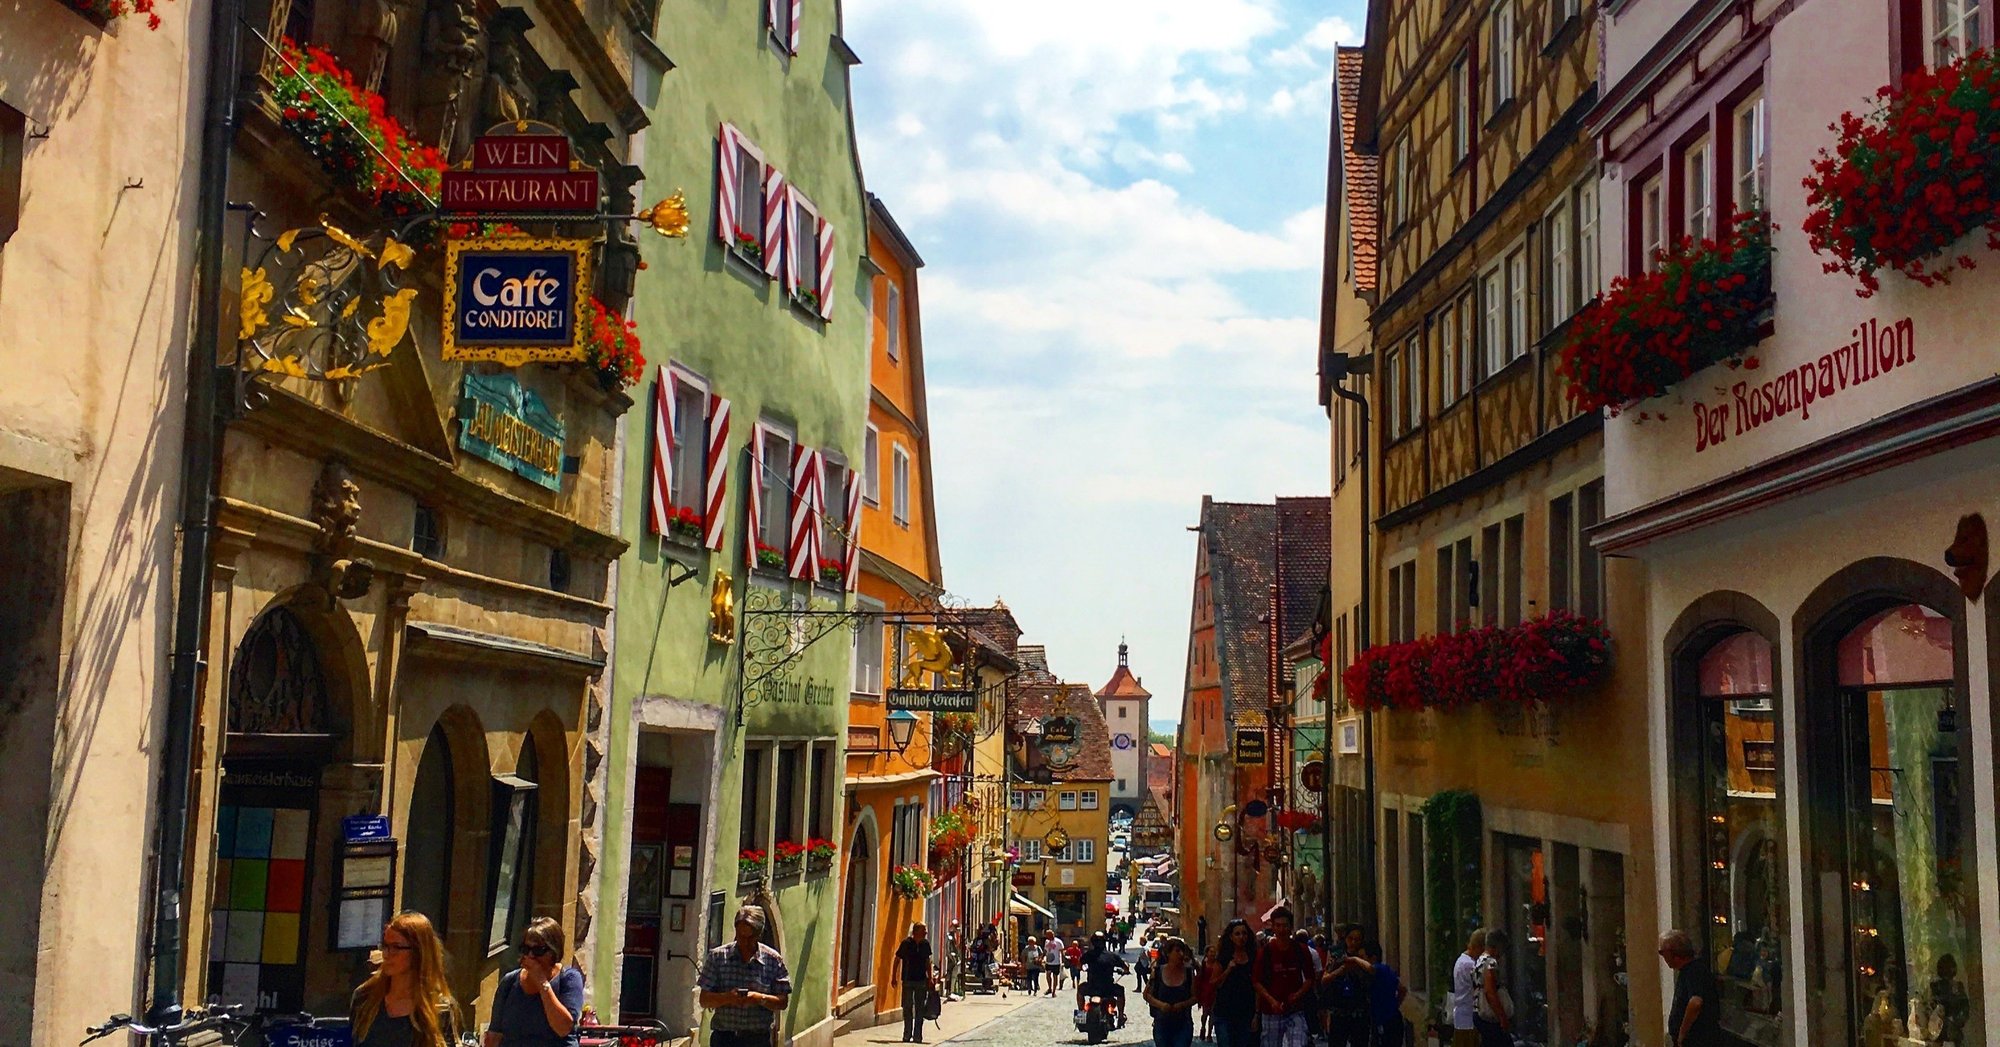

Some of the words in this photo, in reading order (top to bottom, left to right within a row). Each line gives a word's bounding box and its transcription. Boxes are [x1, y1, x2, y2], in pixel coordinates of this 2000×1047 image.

[484, 142, 560, 165] WEIN
[448, 179, 593, 202] RESTAURANT
[472, 267, 560, 307] Cafe
[465, 309, 563, 329] CONDITOREI
[1693, 401, 1729, 453] Der
[1732, 316, 1916, 436] Rosenpavillon
[763, 675, 802, 704] Gasthof
[888, 692, 931, 708] Gasthof
[932, 692, 974, 709] Greifen
[287, 1035, 344, 1047] Speise-
